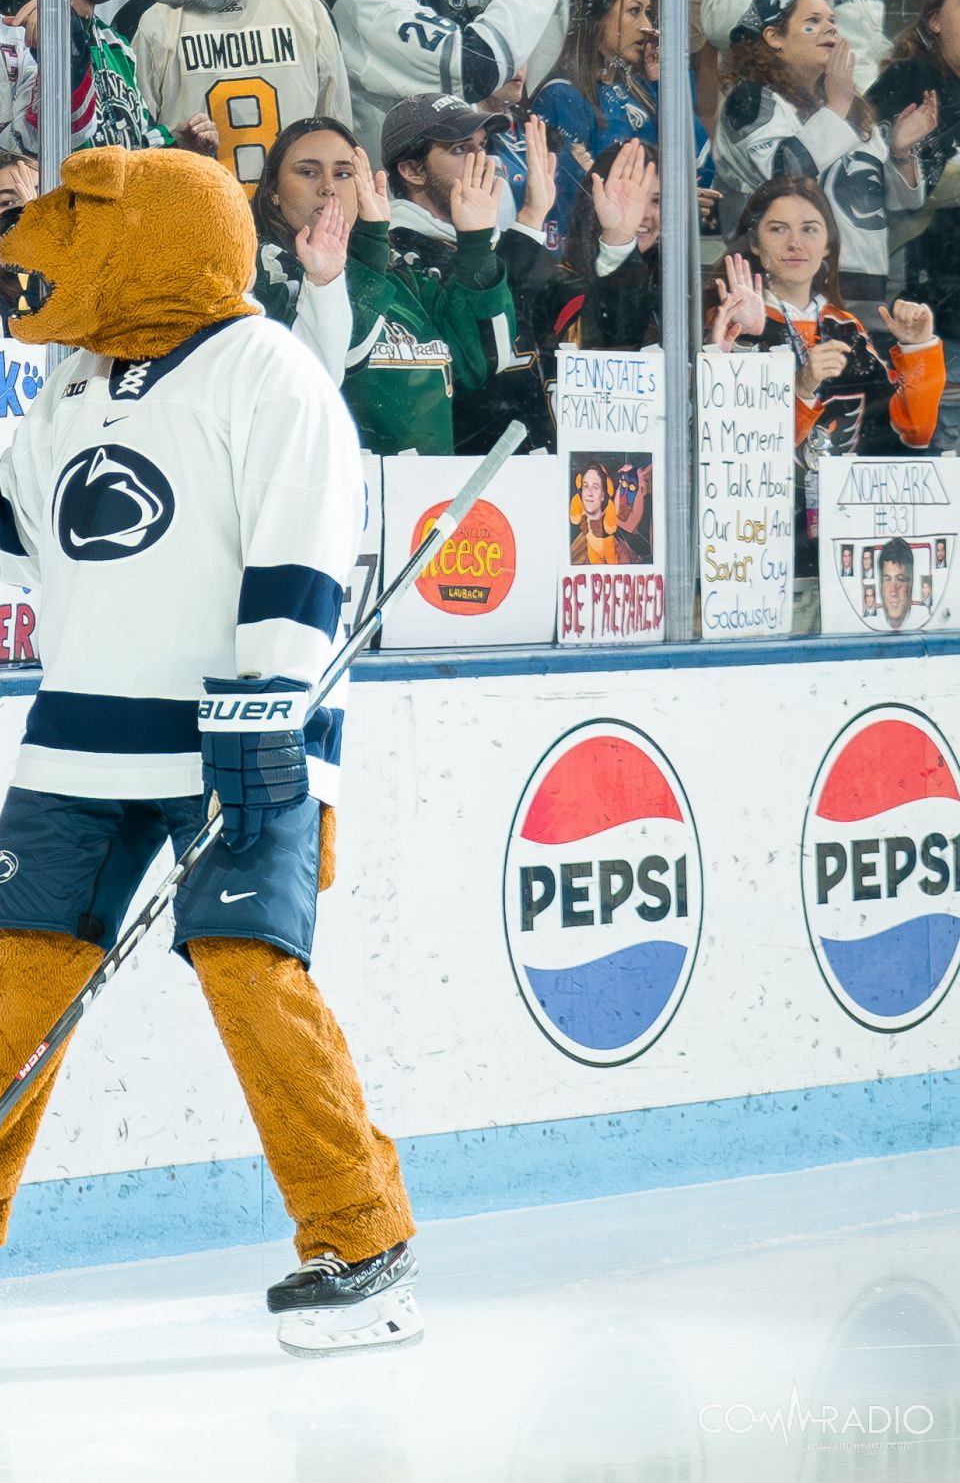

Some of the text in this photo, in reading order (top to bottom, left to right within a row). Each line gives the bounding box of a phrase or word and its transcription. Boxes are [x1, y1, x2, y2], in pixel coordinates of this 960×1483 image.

[181, 27, 295, 71] DUMOULIN
[205, 76, 282, 200] 8
[594, 391, 611, 404] THE
[702, 355, 790, 411] Do You Have
[562, 394, 649, 434] RYAN KING
[701, 420, 784, 455] A Moment
[700, 461, 792, 500] To Talk About
[900, 465, 937, 504] ARK
[702, 506, 791, 546] Our Lord And
[875, 505, 909, 535] #33
[760, 548, 788, 590] Guy
[448, 588, 484, 600] LAUBACH
[562, 573, 664, 638] BE PREPARED
[519, 853, 689, 932] PEPSI
